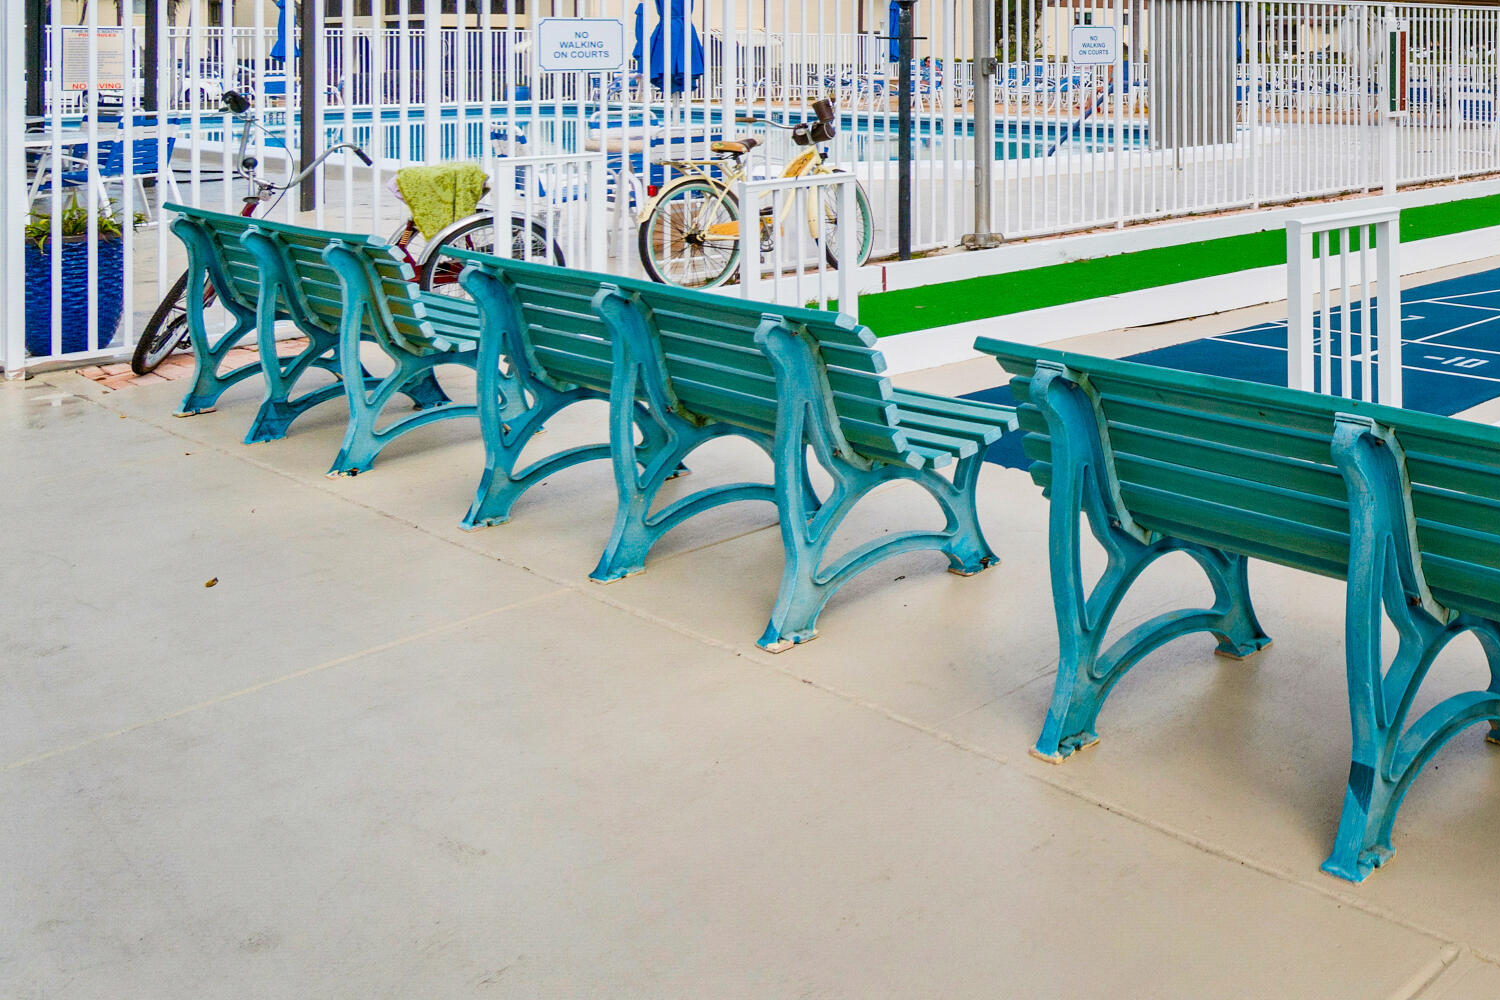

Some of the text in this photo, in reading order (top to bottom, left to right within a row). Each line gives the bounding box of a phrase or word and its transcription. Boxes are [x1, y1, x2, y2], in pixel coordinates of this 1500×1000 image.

[1396, 21, 1401, 30] 2
[575, 31, 589, 39] NO
[559, 41, 604, 49] WALKING
[553, 50, 610, 59] ON COURTS
